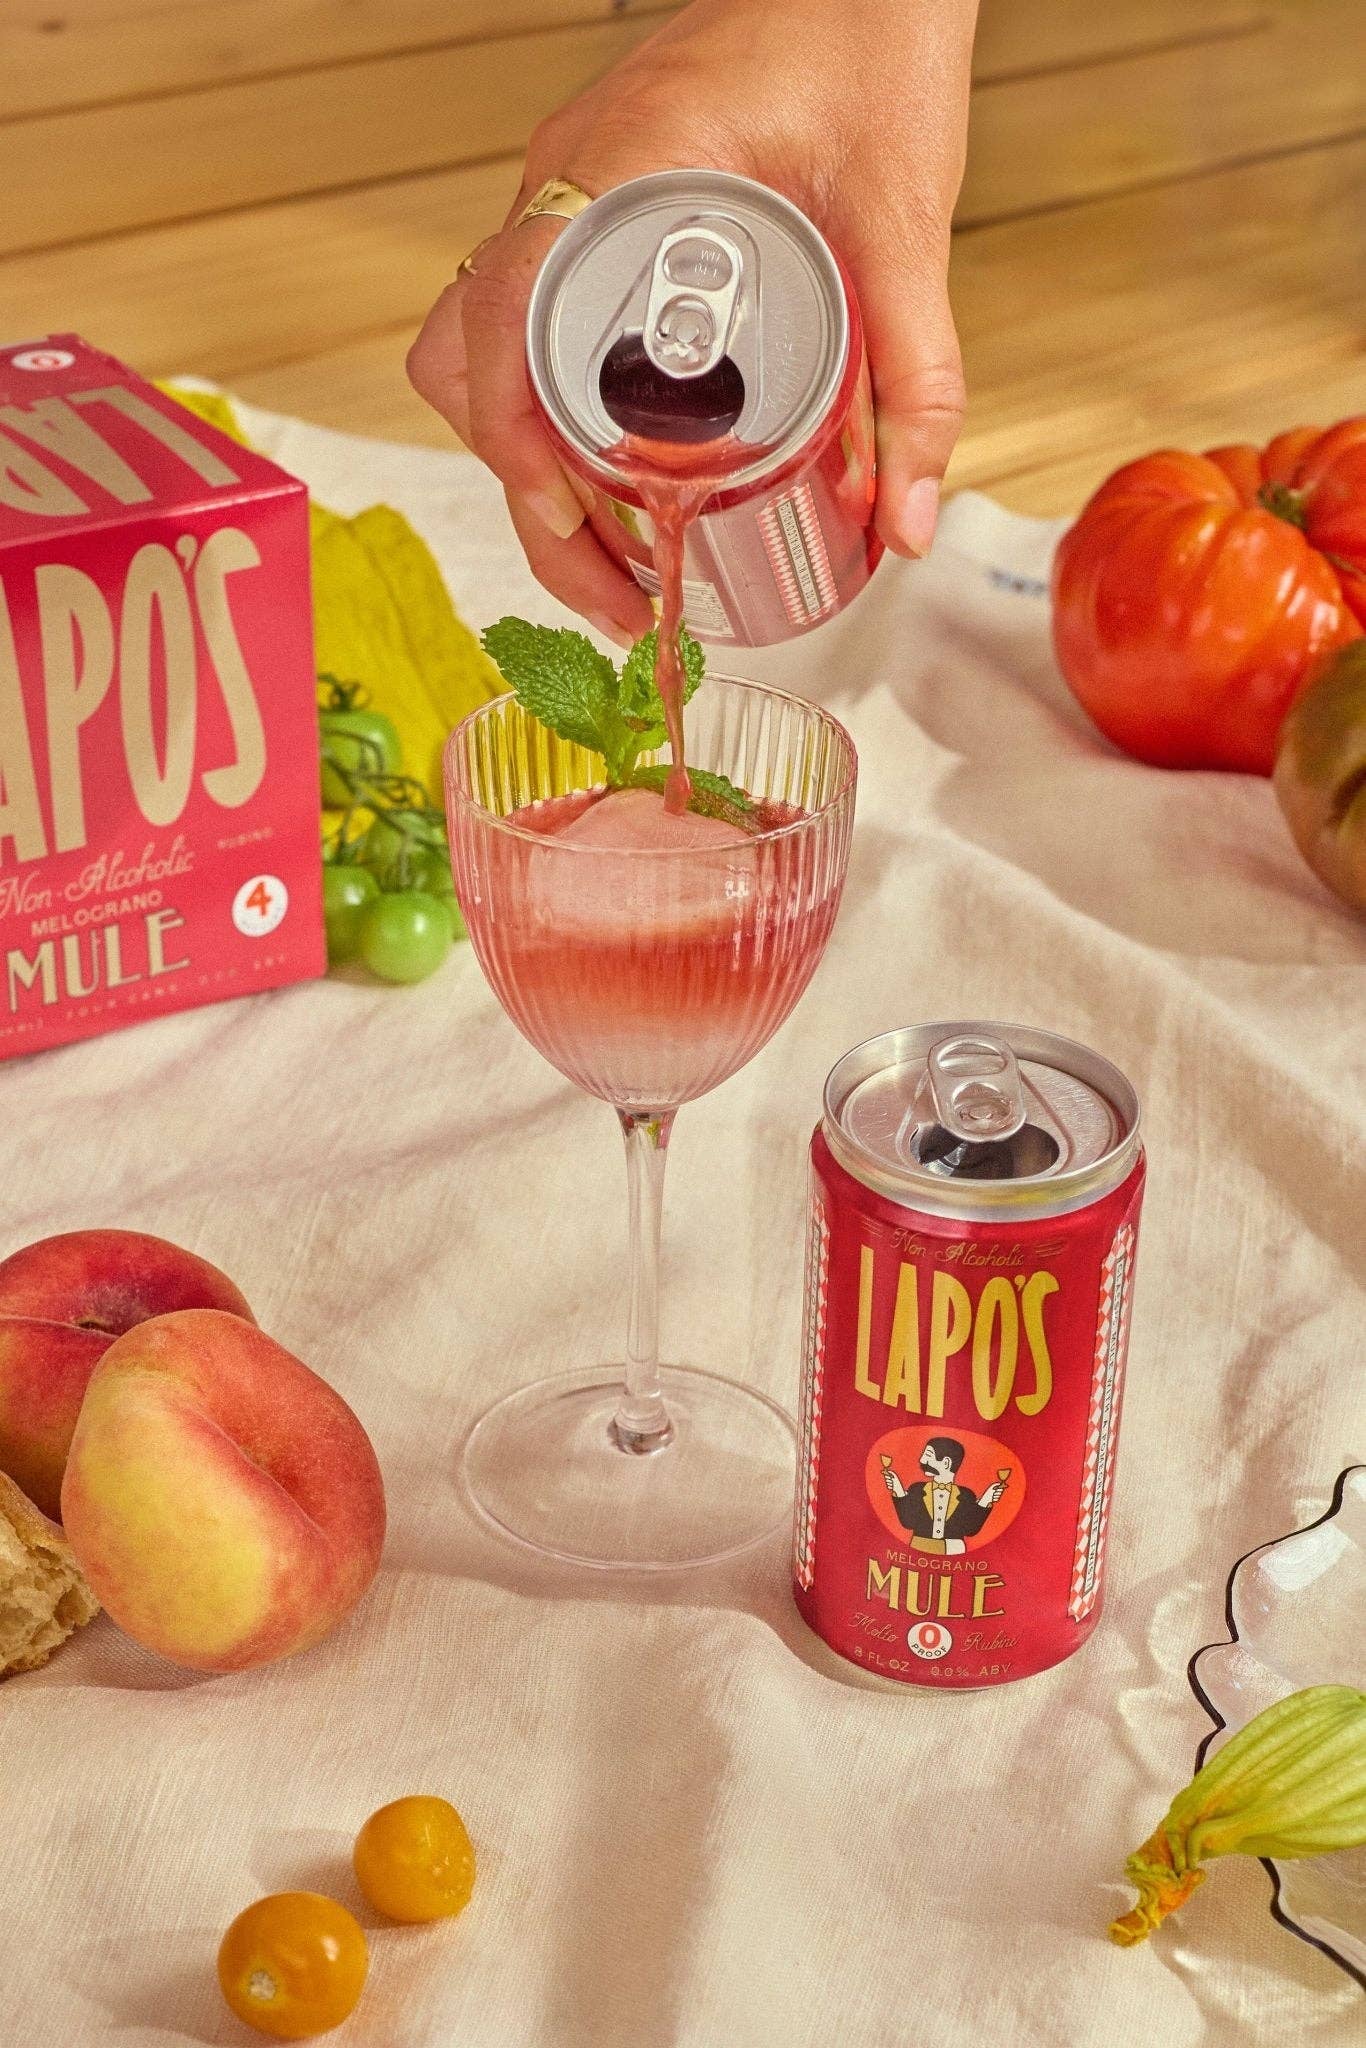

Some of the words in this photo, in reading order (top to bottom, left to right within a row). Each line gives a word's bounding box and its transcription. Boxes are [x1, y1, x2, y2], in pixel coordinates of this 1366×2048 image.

[31, 889, 163, 936] MELOGRANO
[245, 881, 272, 917] 4
[7, 907, 192, 1014] MULE
[890, 1227, 927, 1257] Non
[935, 1241, 1025, 1266] Alcoholic
[855, 1244, 1060, 1421] LAPO'S
[886, 1550, 988, 1571] MELOGRANO
[866, 1557, 1006, 1620] MULE
[911, 1643, 948, 1658] PROOF
[918, 1624, 941, 1650] 0
[854, 1645, 863, 1658] 8
[868, 1651, 886, 1667] FL
[888, 1659, 910, 1673] OZ
[979, 1662, 1011, 1677] ABV
